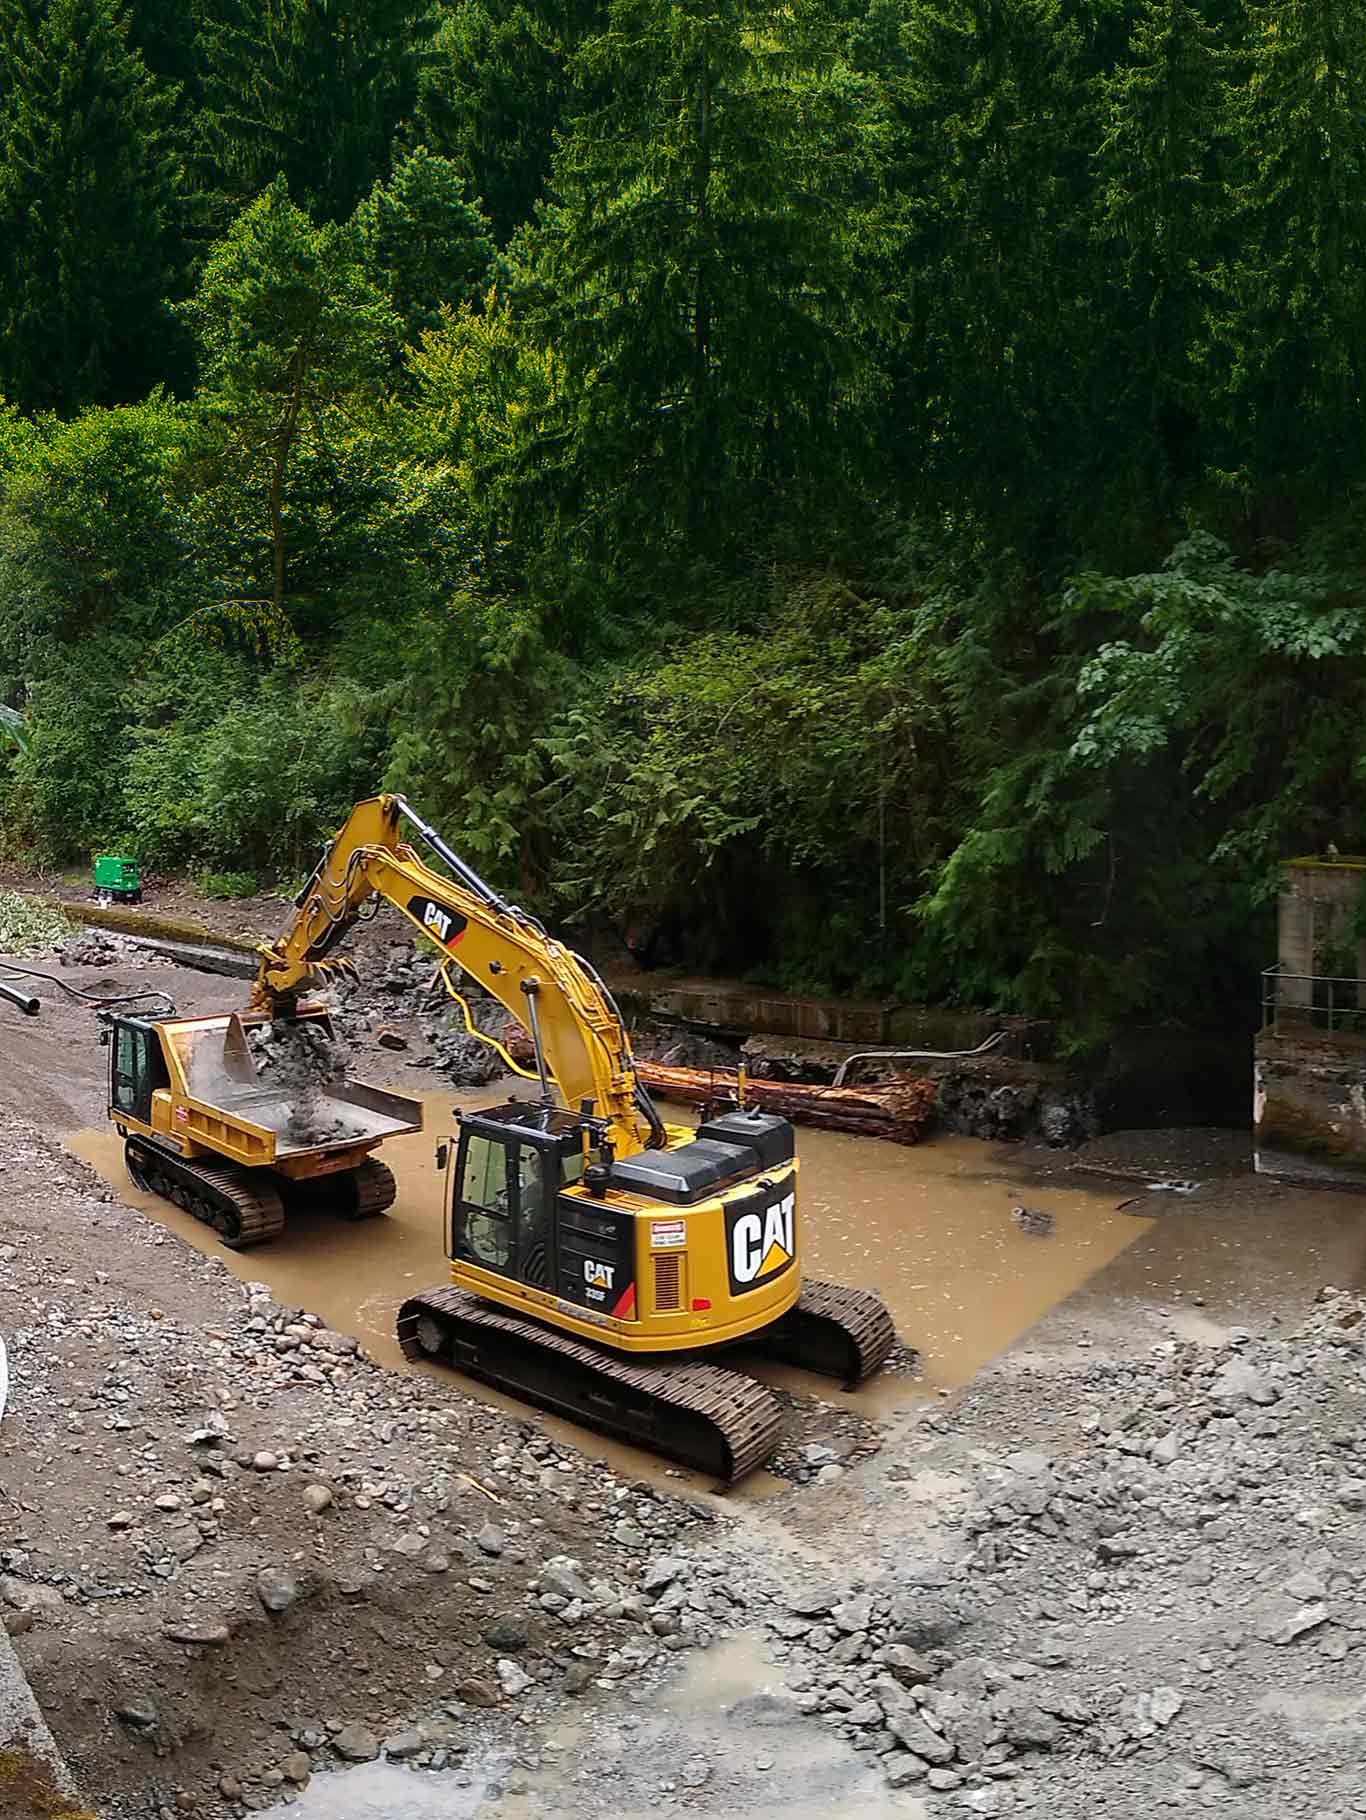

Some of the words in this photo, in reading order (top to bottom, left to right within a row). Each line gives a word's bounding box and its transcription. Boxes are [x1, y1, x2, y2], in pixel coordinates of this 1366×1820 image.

[423, 902, 452, 940] CAT
[733, 1191, 795, 1283] CAT
[583, 1260, 616, 1289] CAT
